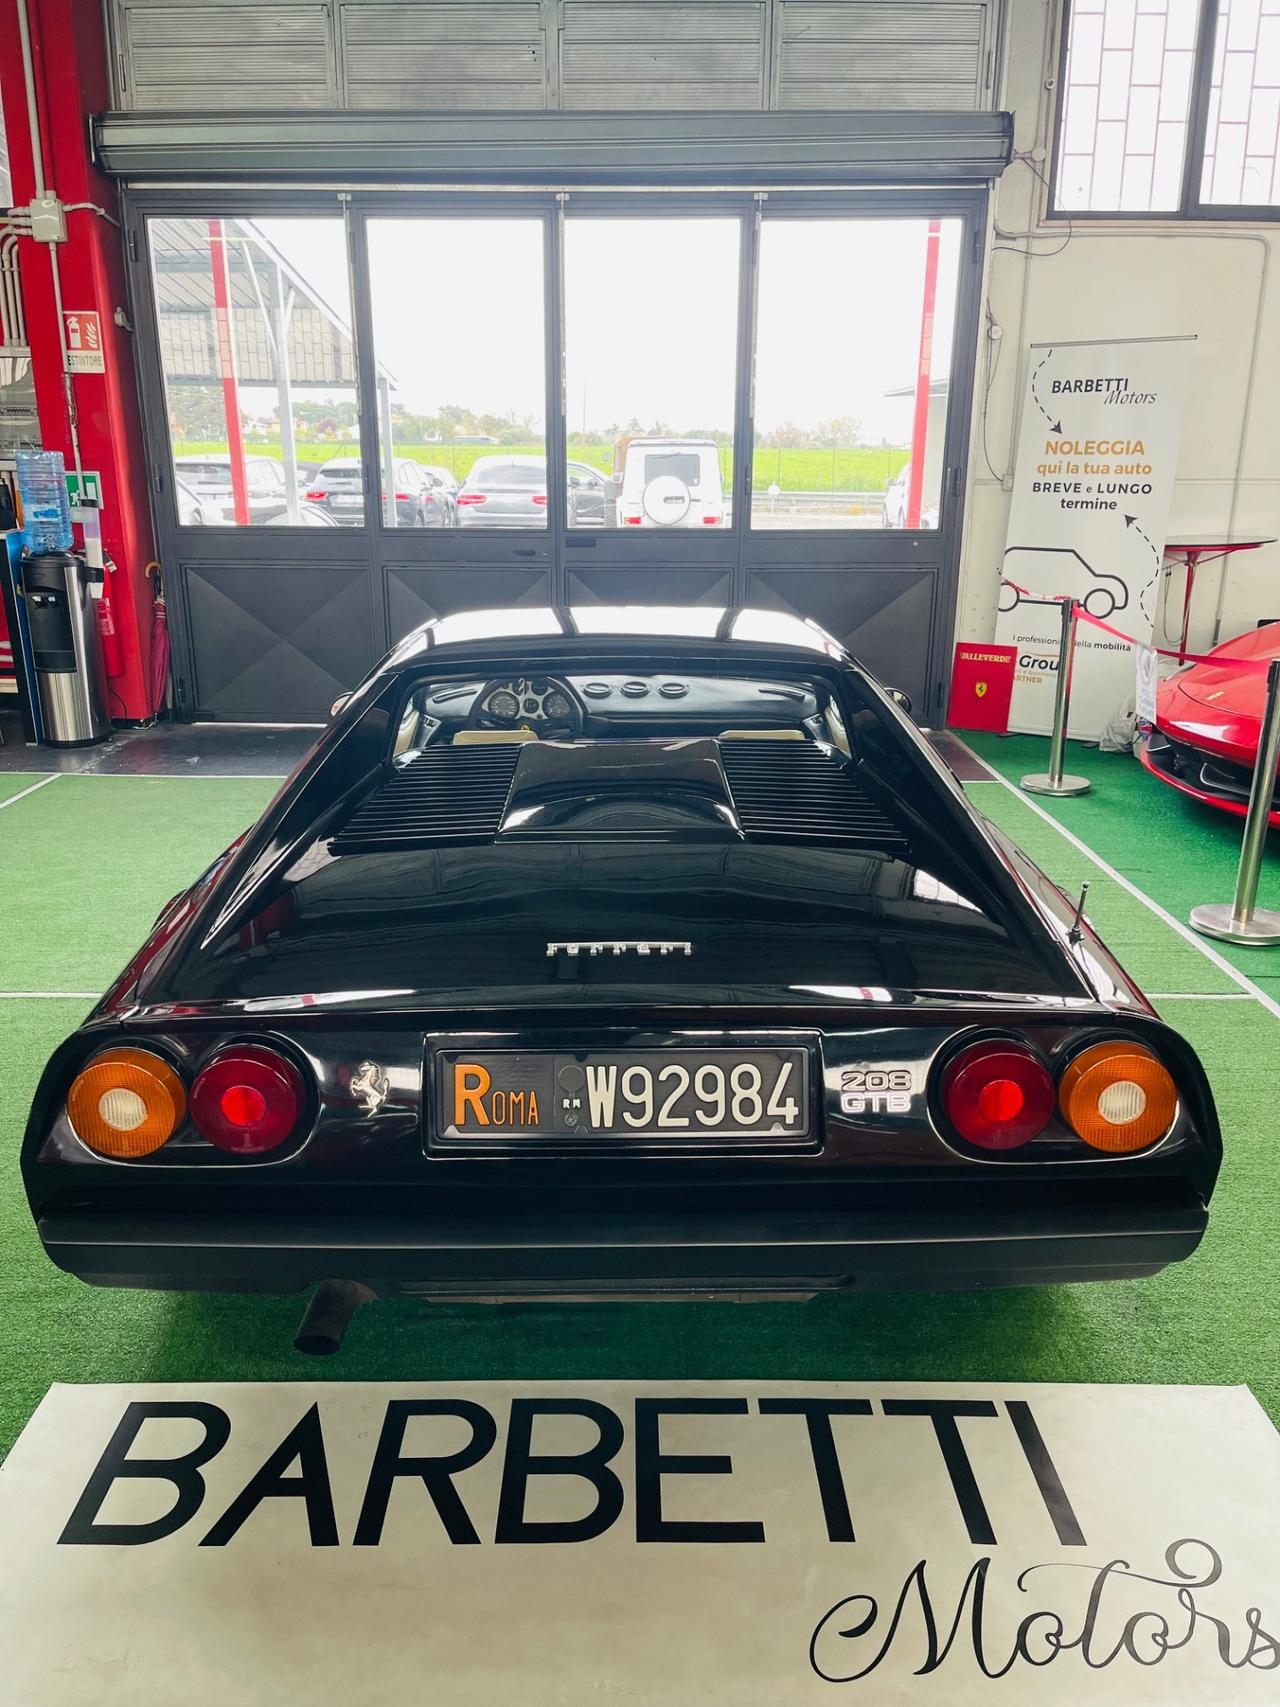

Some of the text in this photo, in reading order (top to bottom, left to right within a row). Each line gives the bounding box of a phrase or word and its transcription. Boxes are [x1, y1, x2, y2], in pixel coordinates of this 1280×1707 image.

[67, 355, 103, 367] ESTINTORE
[1051, 378, 1129, 394] BARBETTI
[1103, 390, 1158, 405] Motors
[1044, 440, 1145, 455] NOLEGGIA
[1036, 461, 1153, 477] qui la tua auto
[1032, 482, 1153, 495] BREVE e LUNGO
[1061, 498, 1118, 510] termine
[1093, 641, 1132, 652] mobilità
[1019, 654, 1060, 671] Grou
[546, 941, 692, 957] Ferrari
[841, 1069, 912, 1092] 208
[454, 1063, 540, 1126] ROMA
[586, 1062, 800, 1128] W92984
[840, 1091, 912, 1114] GTB
[57, 1398, 1087, 1547] BARBETTI
[809, 1537, 1280, 1683] Motors
